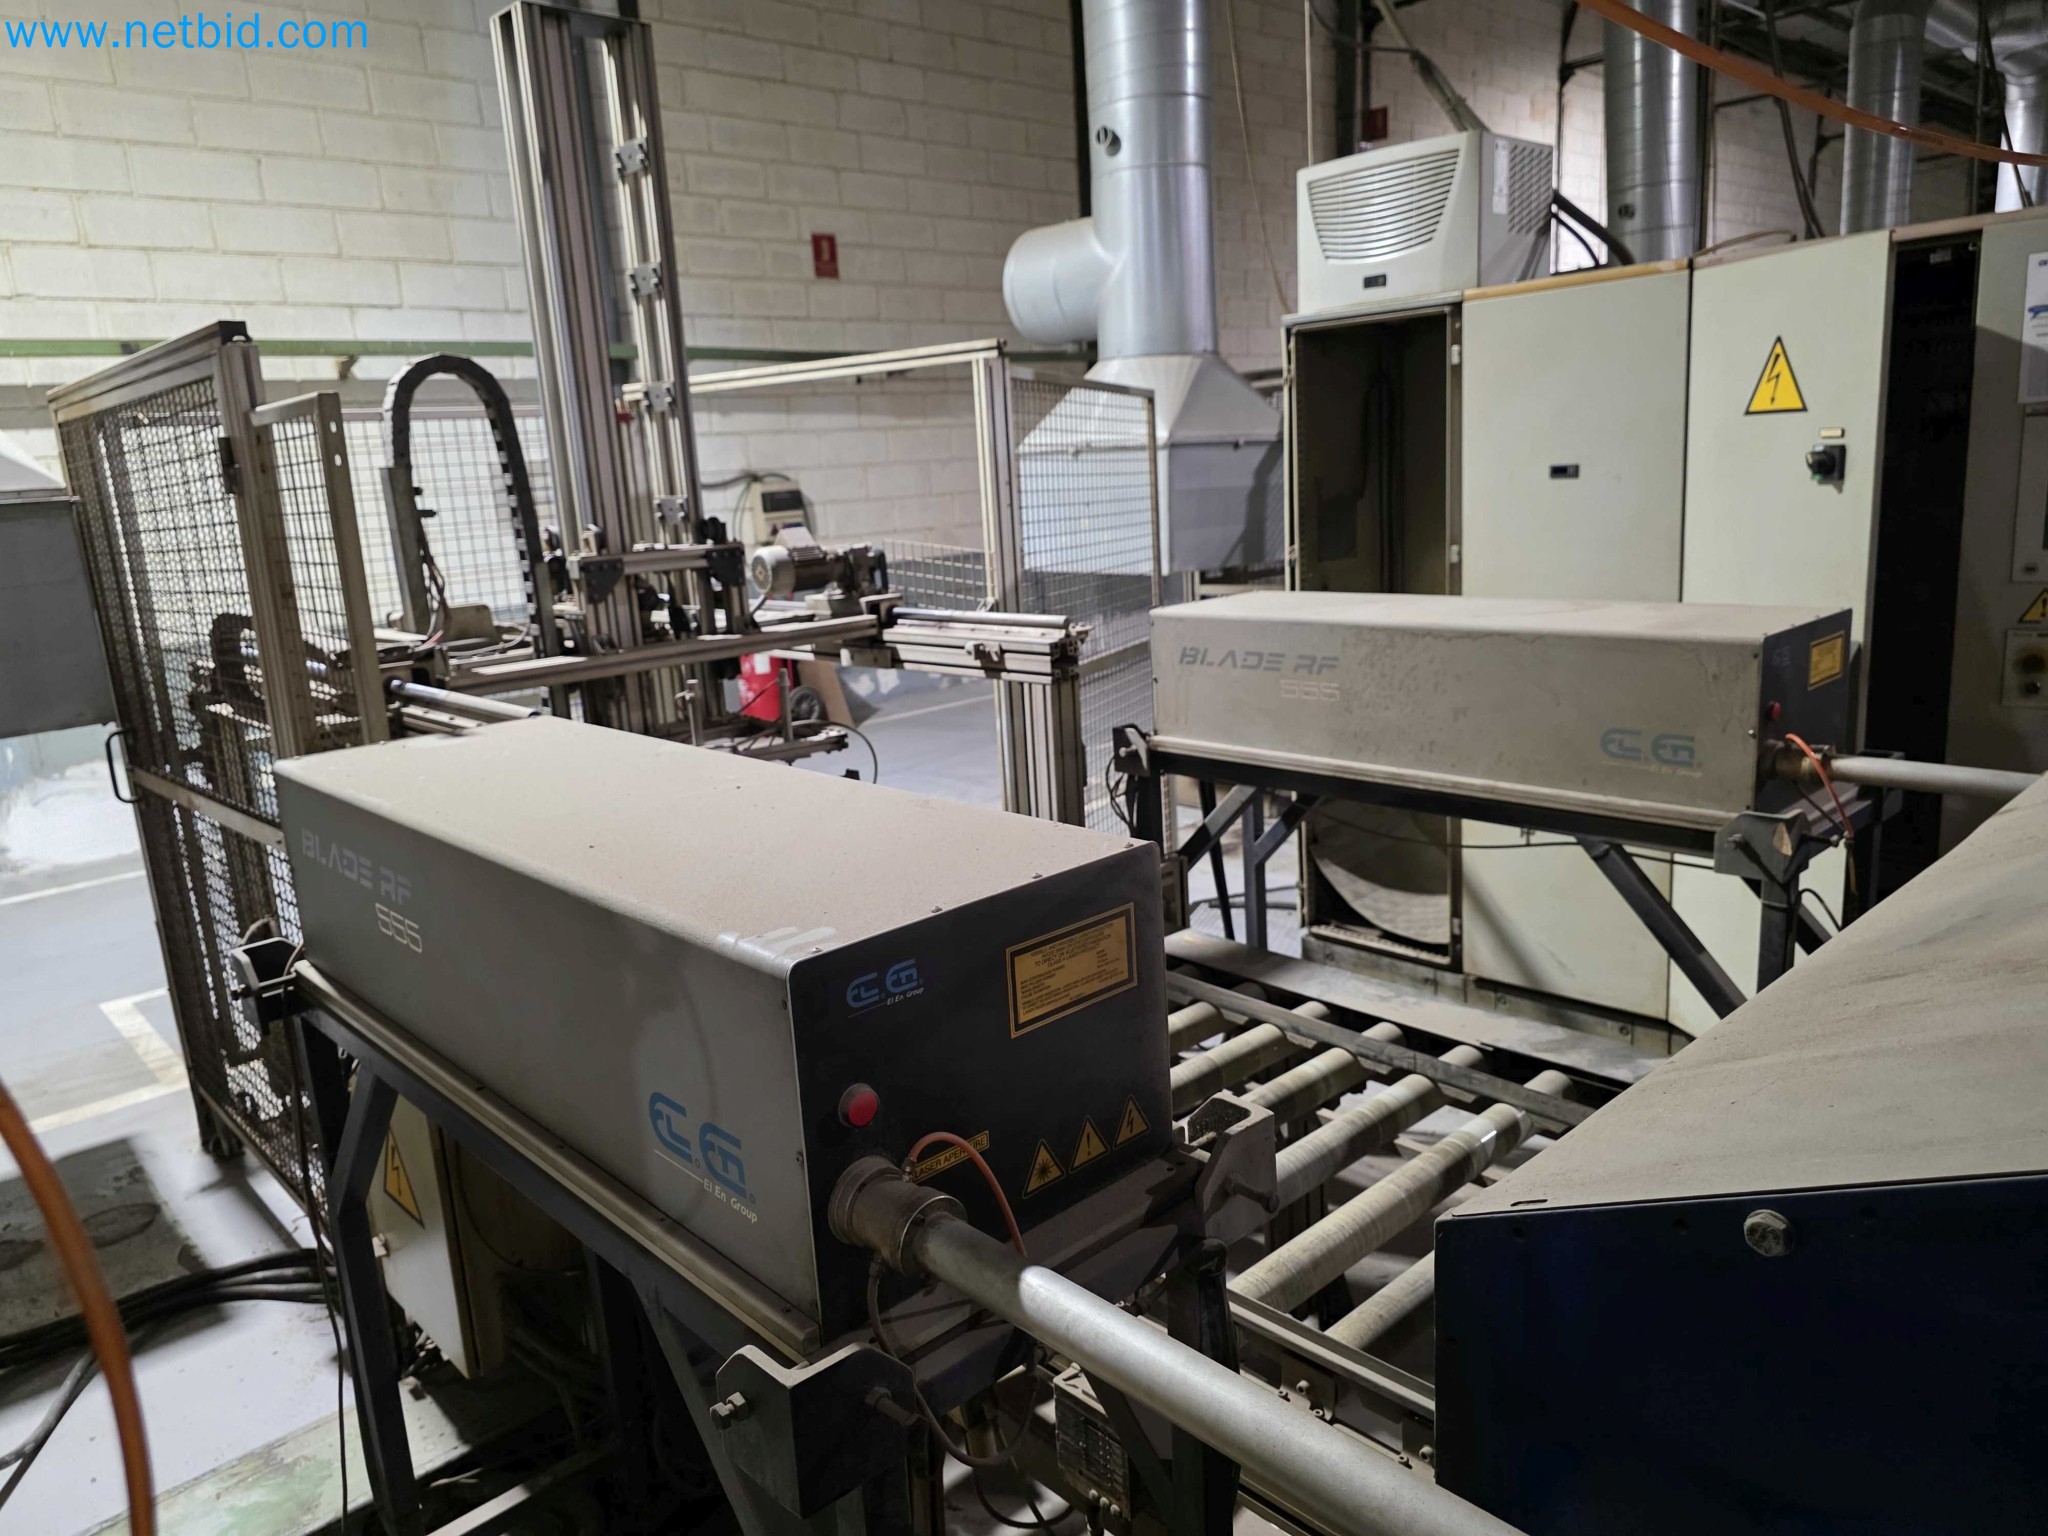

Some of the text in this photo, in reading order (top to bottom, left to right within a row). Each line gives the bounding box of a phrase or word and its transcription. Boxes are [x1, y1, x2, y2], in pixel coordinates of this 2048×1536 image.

[1179, 646, 1340, 676] BLADE RF
[301, 826, 412, 905] BLADE RF
[914, 1138, 986, 1178] LASER APERRE
[730, 1197, 758, 1224] Group
